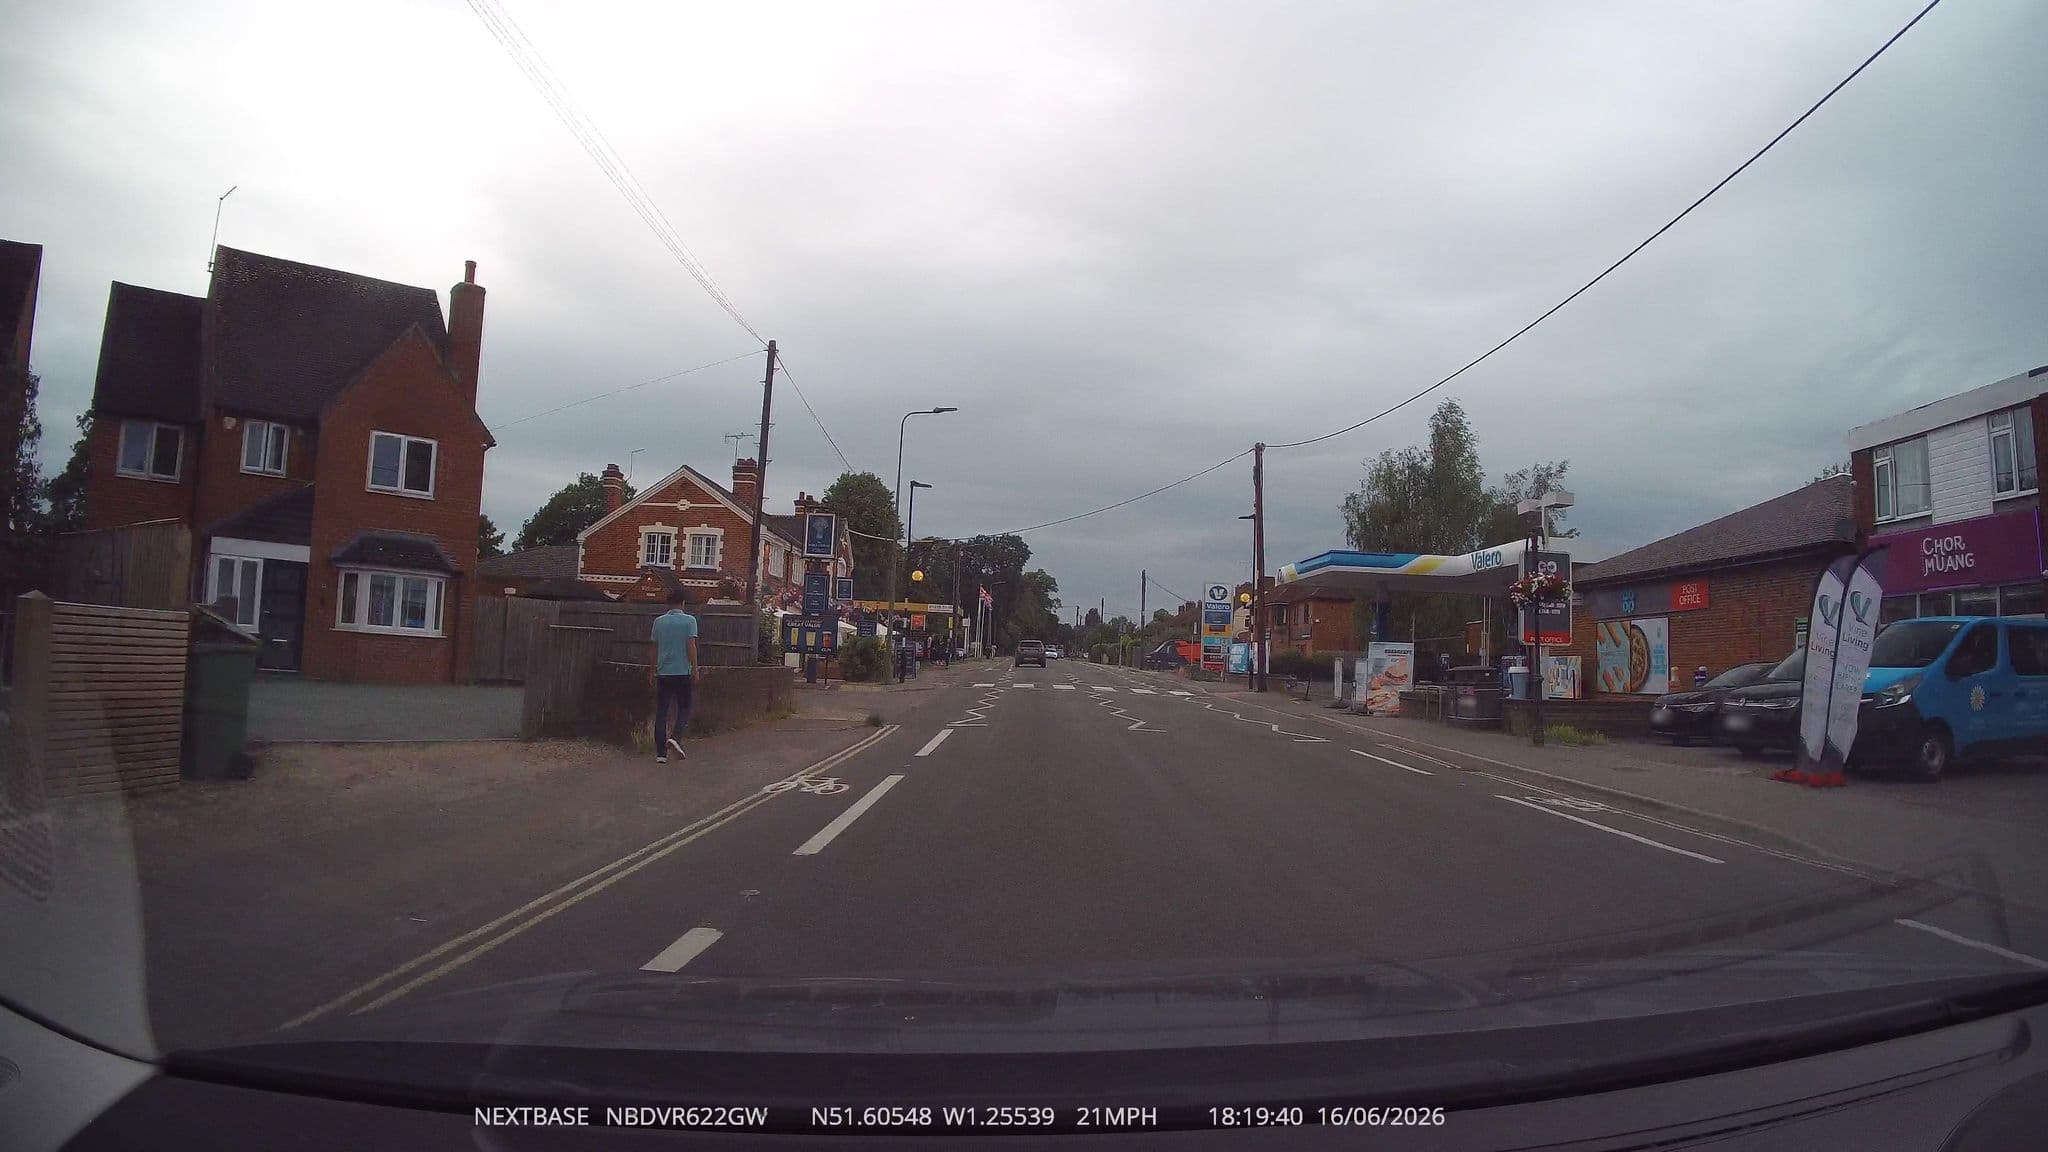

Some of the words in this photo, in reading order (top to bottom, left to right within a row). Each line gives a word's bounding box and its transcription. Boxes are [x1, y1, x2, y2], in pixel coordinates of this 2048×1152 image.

[1922, 535, 1966, 556] CHOR
[1470, 550, 1503, 571] Valero
[1923, 552, 1975, 577] MUANG
[1681, 583, 1698, 595] POST
[1206, 602, 1231, 610] Valero
[1679, 594, 1701, 605] OFFICE
[1810, 641, 1836, 660] Living
[1842, 632, 1870, 652] Living
